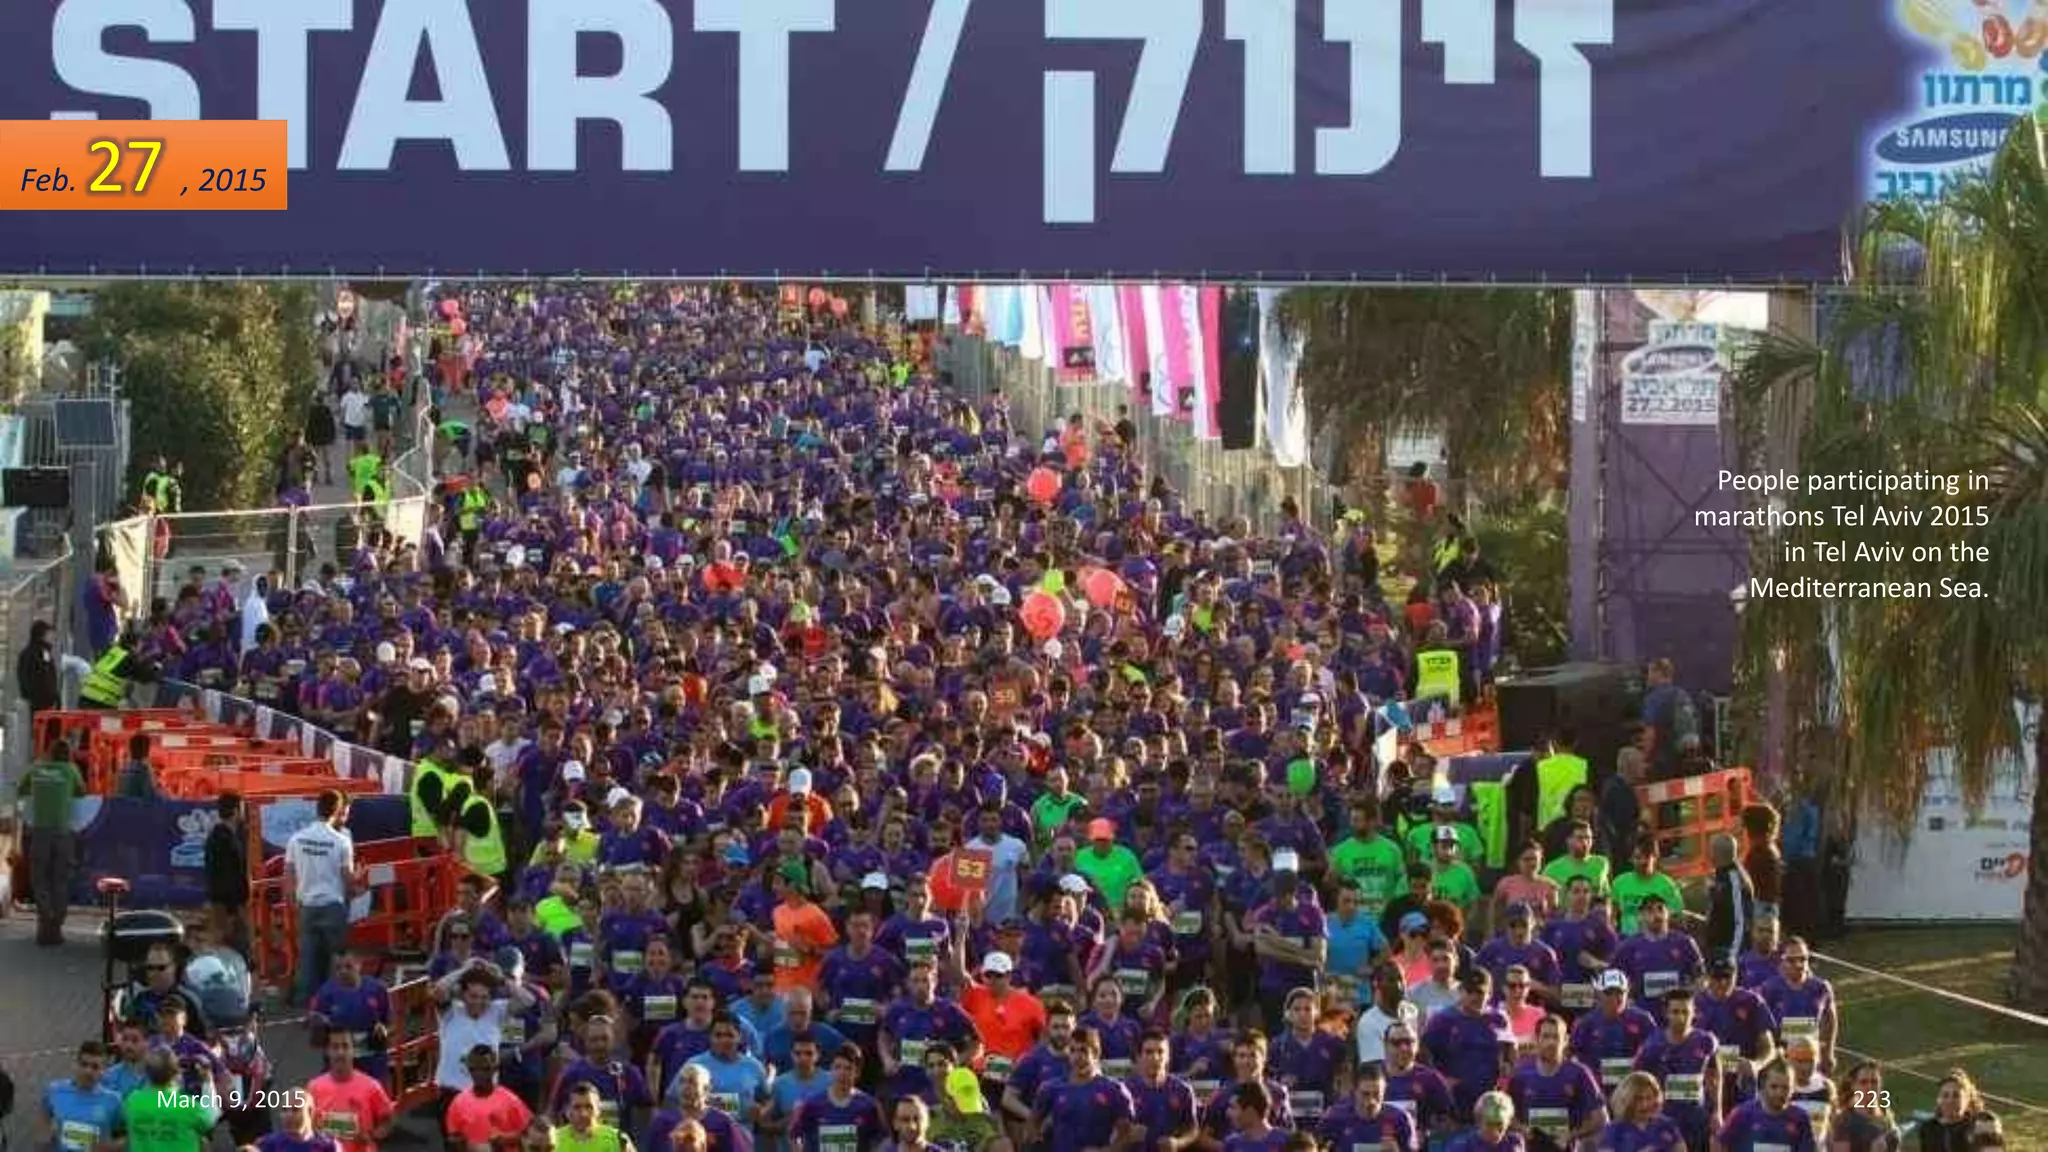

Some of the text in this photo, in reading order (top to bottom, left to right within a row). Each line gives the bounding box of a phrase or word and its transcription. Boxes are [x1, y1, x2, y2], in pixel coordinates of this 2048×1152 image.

[1924, 74, 2032, 107] מרתון
[49, 0, 1614, 222] START / זינוק
[957, 858, 986, 878] 53
